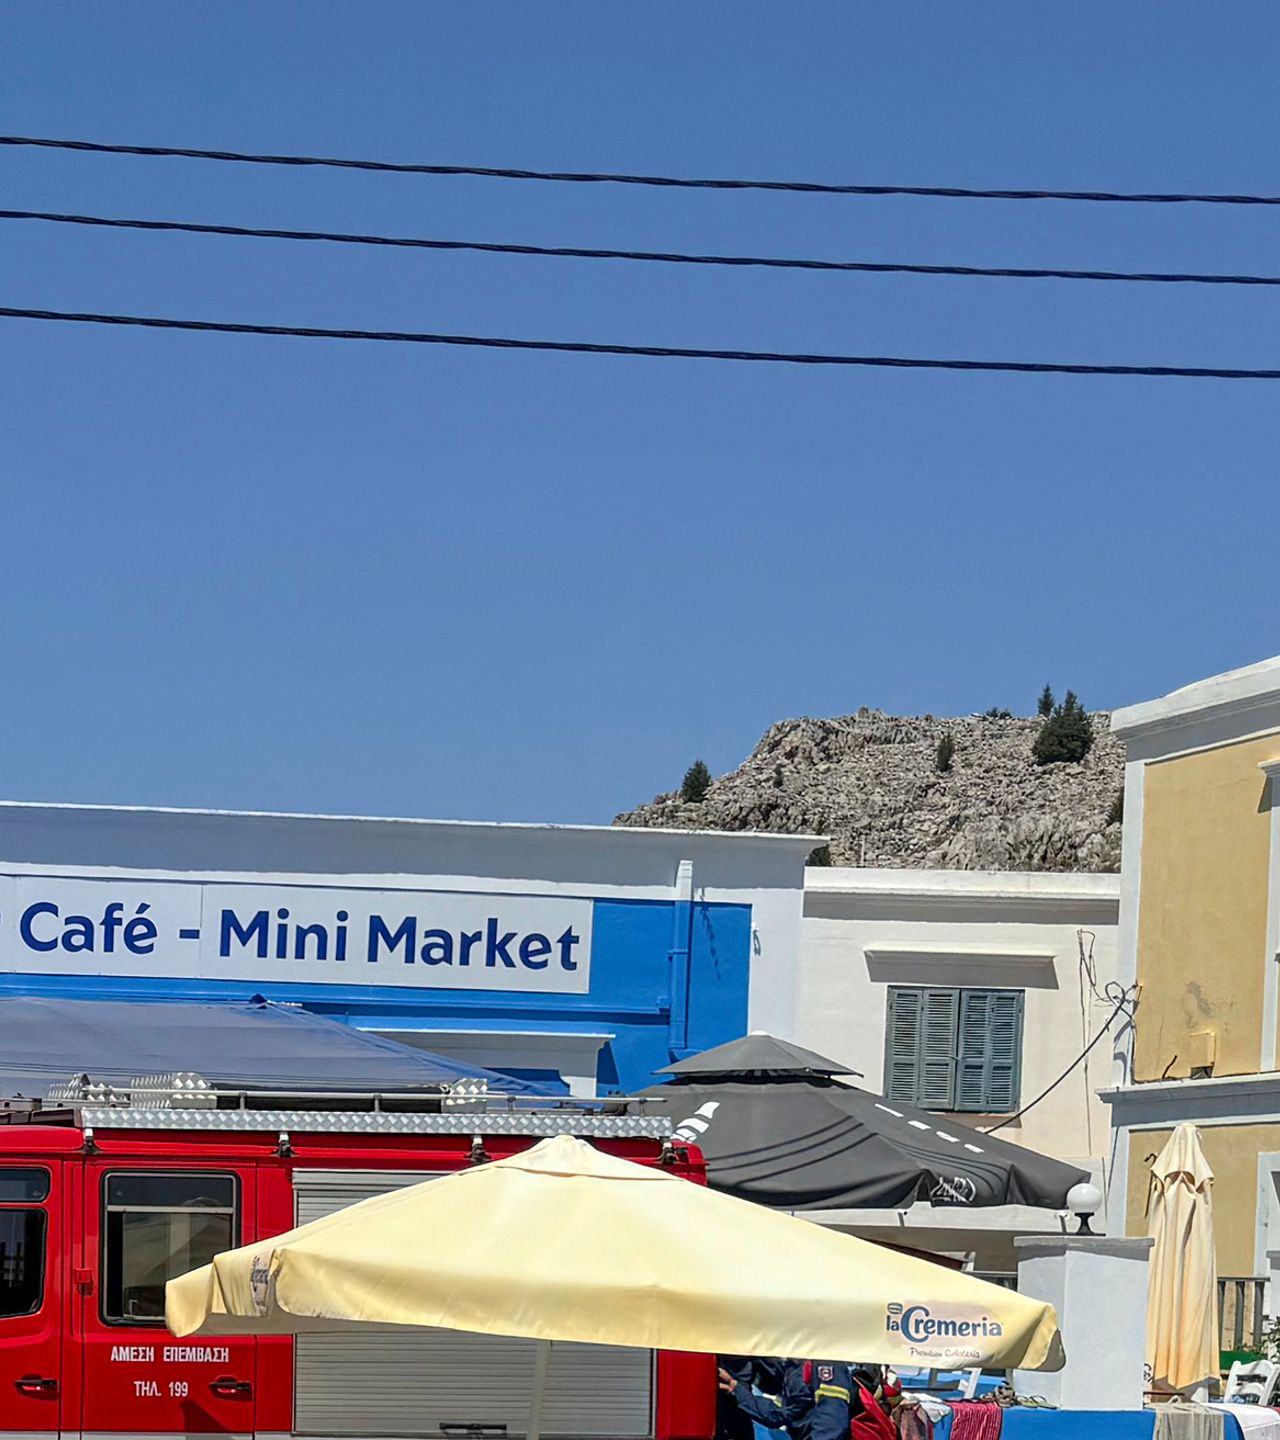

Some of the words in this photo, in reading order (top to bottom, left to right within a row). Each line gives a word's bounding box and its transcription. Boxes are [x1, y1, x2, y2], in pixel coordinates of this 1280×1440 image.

[19, 902, 158, 955] Café
[178, 928, 200, 940] -
[219, 907, 349, 962] Mini
[367, 914, 581, 971] Market
[886, 1314, 900, 1331] la
[900, 1305, 1002, 1343] Cremeria
[110, 1346, 154, 1362] ΑΜΕΣΗ
[163, 1346, 230, 1363] ΕΠΕΜΒΑΣΗ
[133, 1381, 162, 1397] ΤΗΛ.
[168, 1381, 189, 1397] 199
